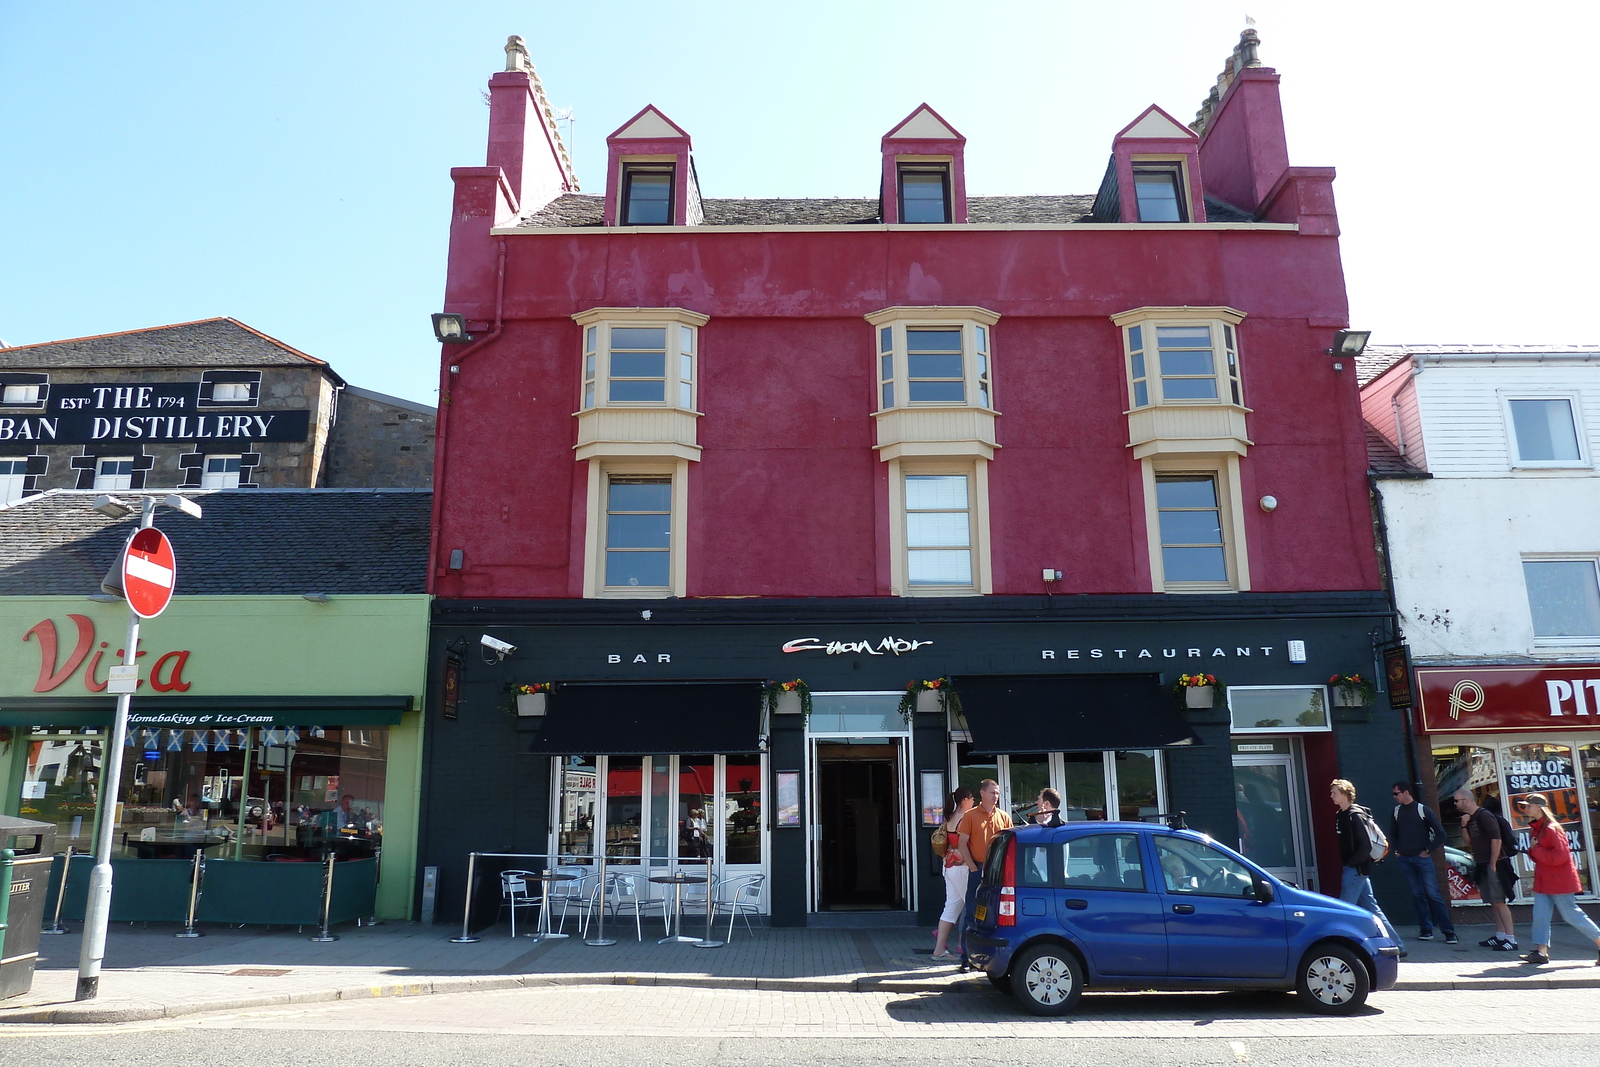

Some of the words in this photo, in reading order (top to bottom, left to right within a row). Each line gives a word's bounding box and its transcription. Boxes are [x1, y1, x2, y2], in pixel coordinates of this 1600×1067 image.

[93, 387, 154, 409] THE
[157, 397, 185, 408] 1794
[91, 415, 275, 439] DISTILLERY
[782, 638, 884, 655] Cuan
[1041, 646, 1273, 660] RESTAURANT
[608, 654, 671, 664] BAR
[1545, 679, 1600, 716] PIT
[126, 713, 197, 725] Homebaking
[215, 714, 274, 723] Ice-Cream
[1511, 761, 1542, 774] END
[1545, 760, 1566, 774] OF
[1511, 774, 1571, 788] SEASON
[1512, 790, 1579, 827] SLE
[1447, 869, 1472, 895] SALE
